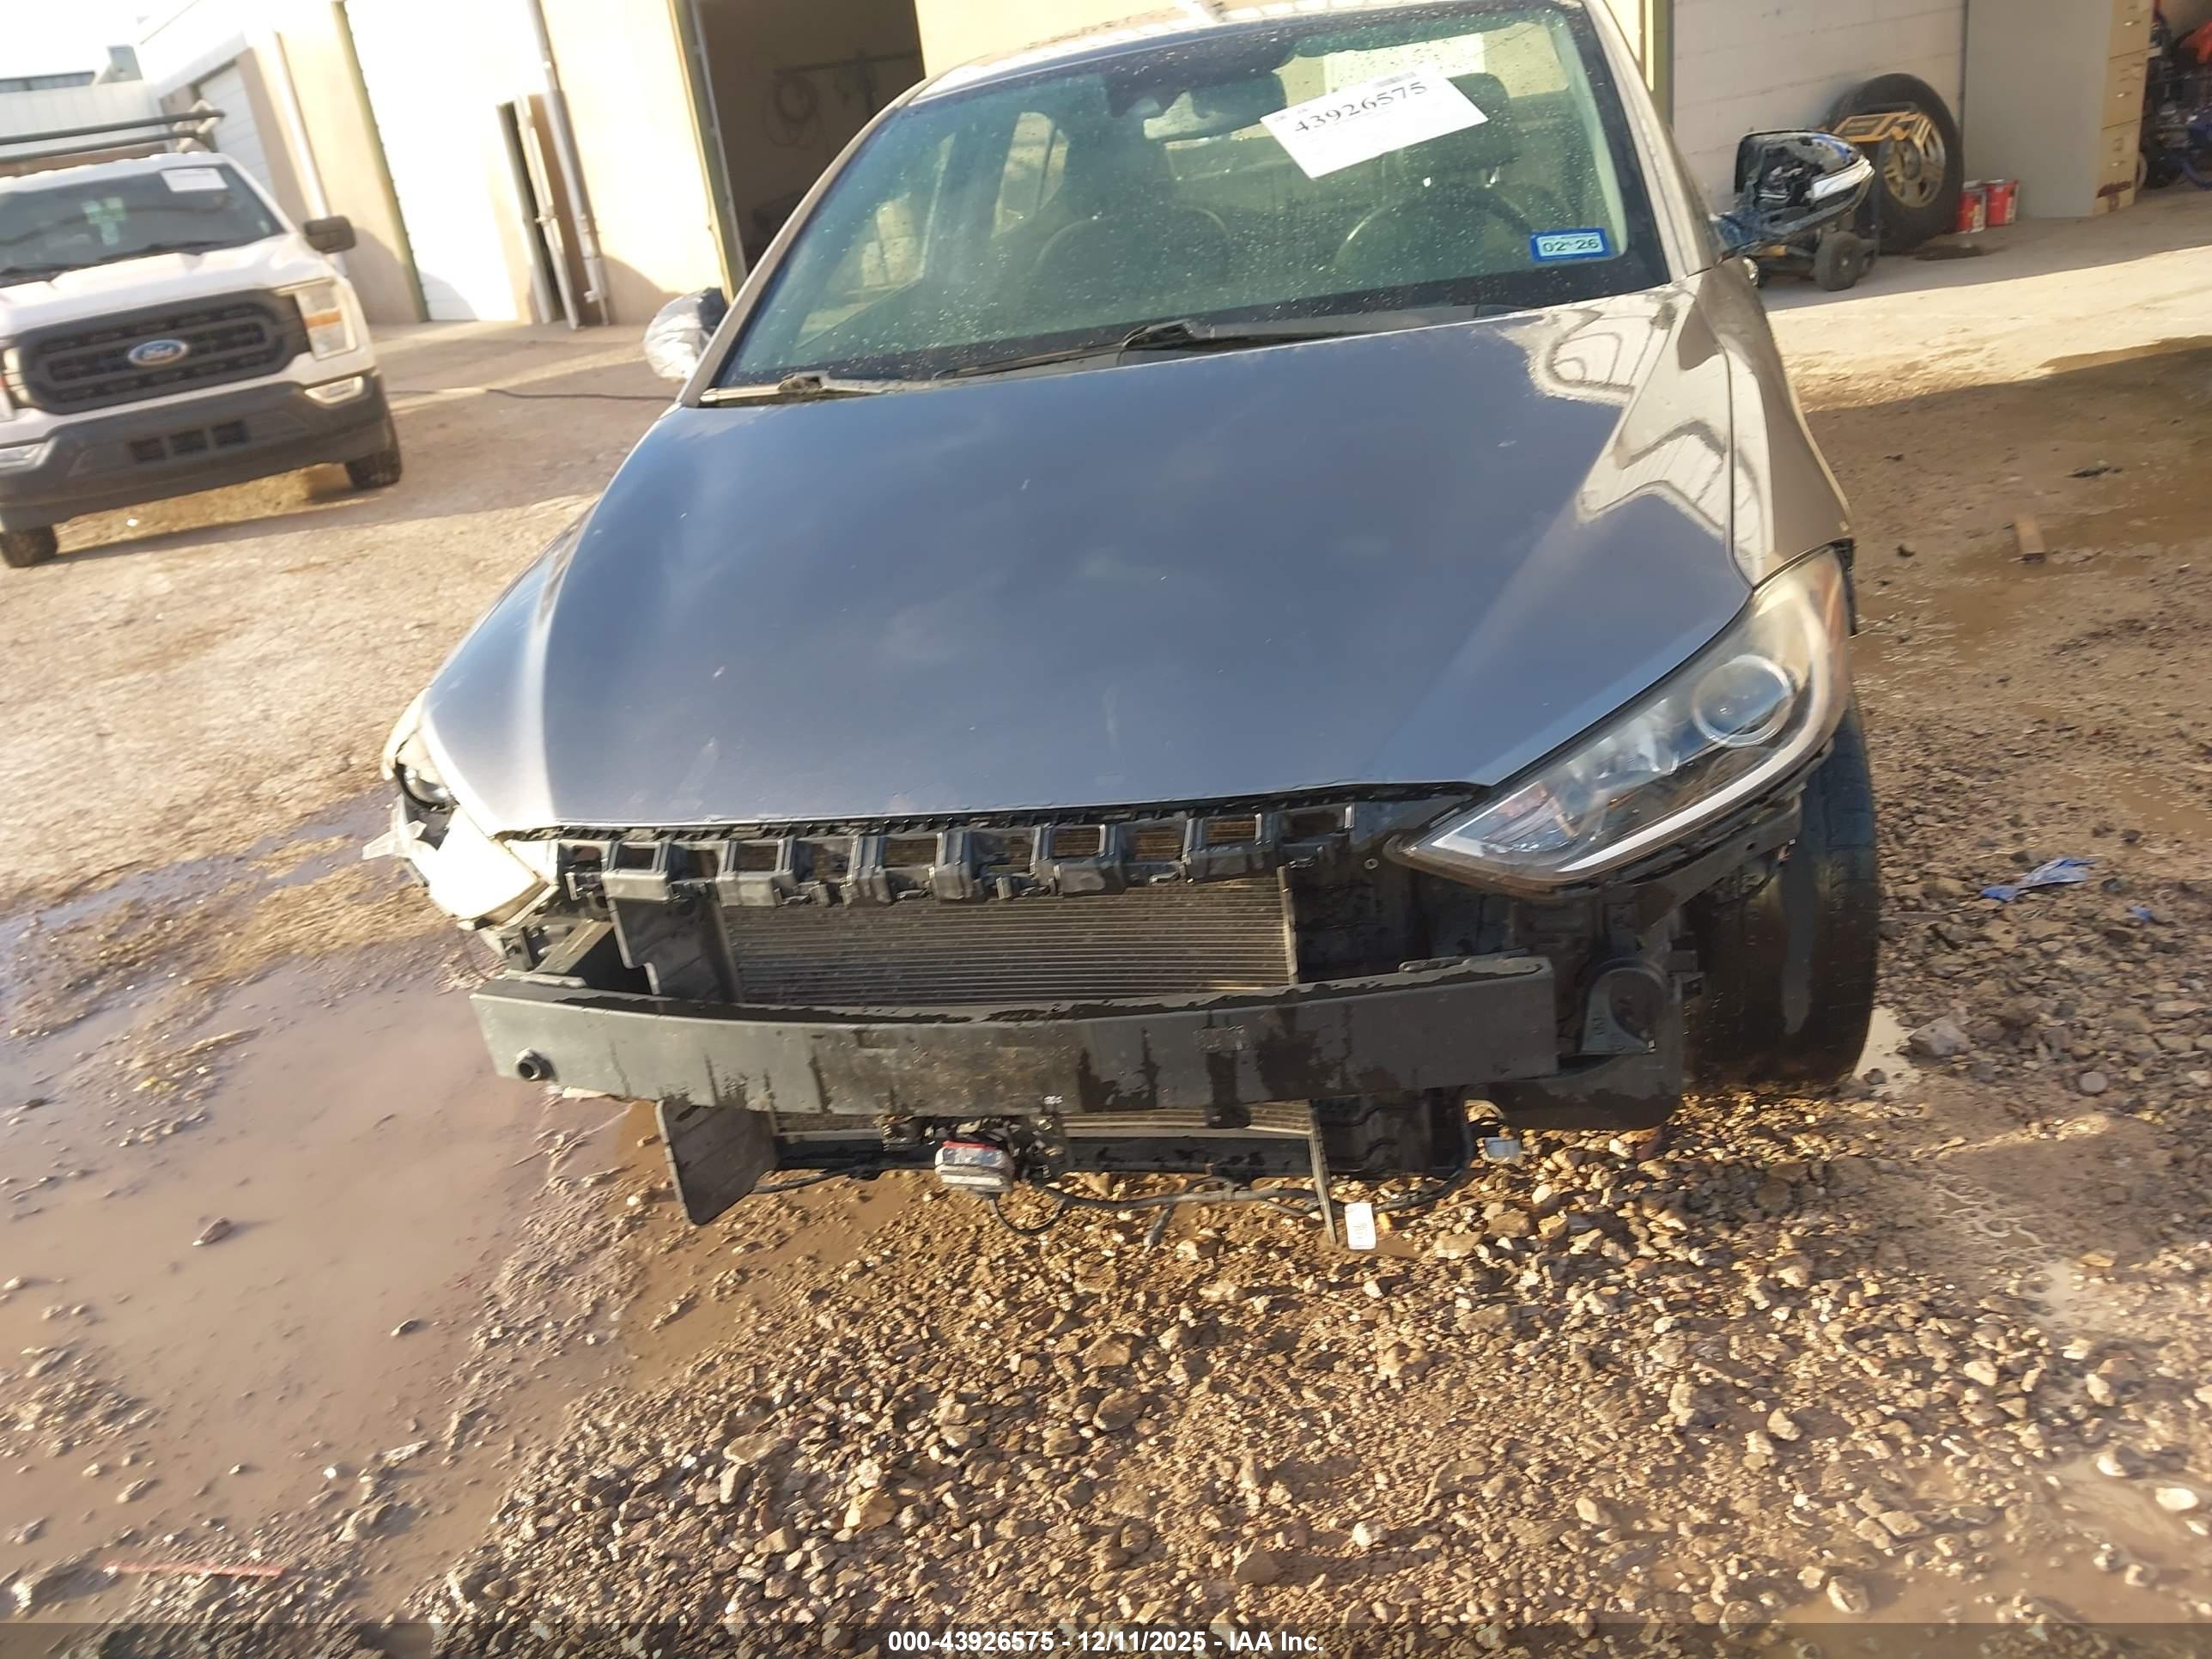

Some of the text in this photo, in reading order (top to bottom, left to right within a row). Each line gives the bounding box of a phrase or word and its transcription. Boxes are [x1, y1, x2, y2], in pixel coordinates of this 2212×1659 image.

[1294, 81, 1428, 132] 43926575
[1542, 239, 1599, 252] 02 26
